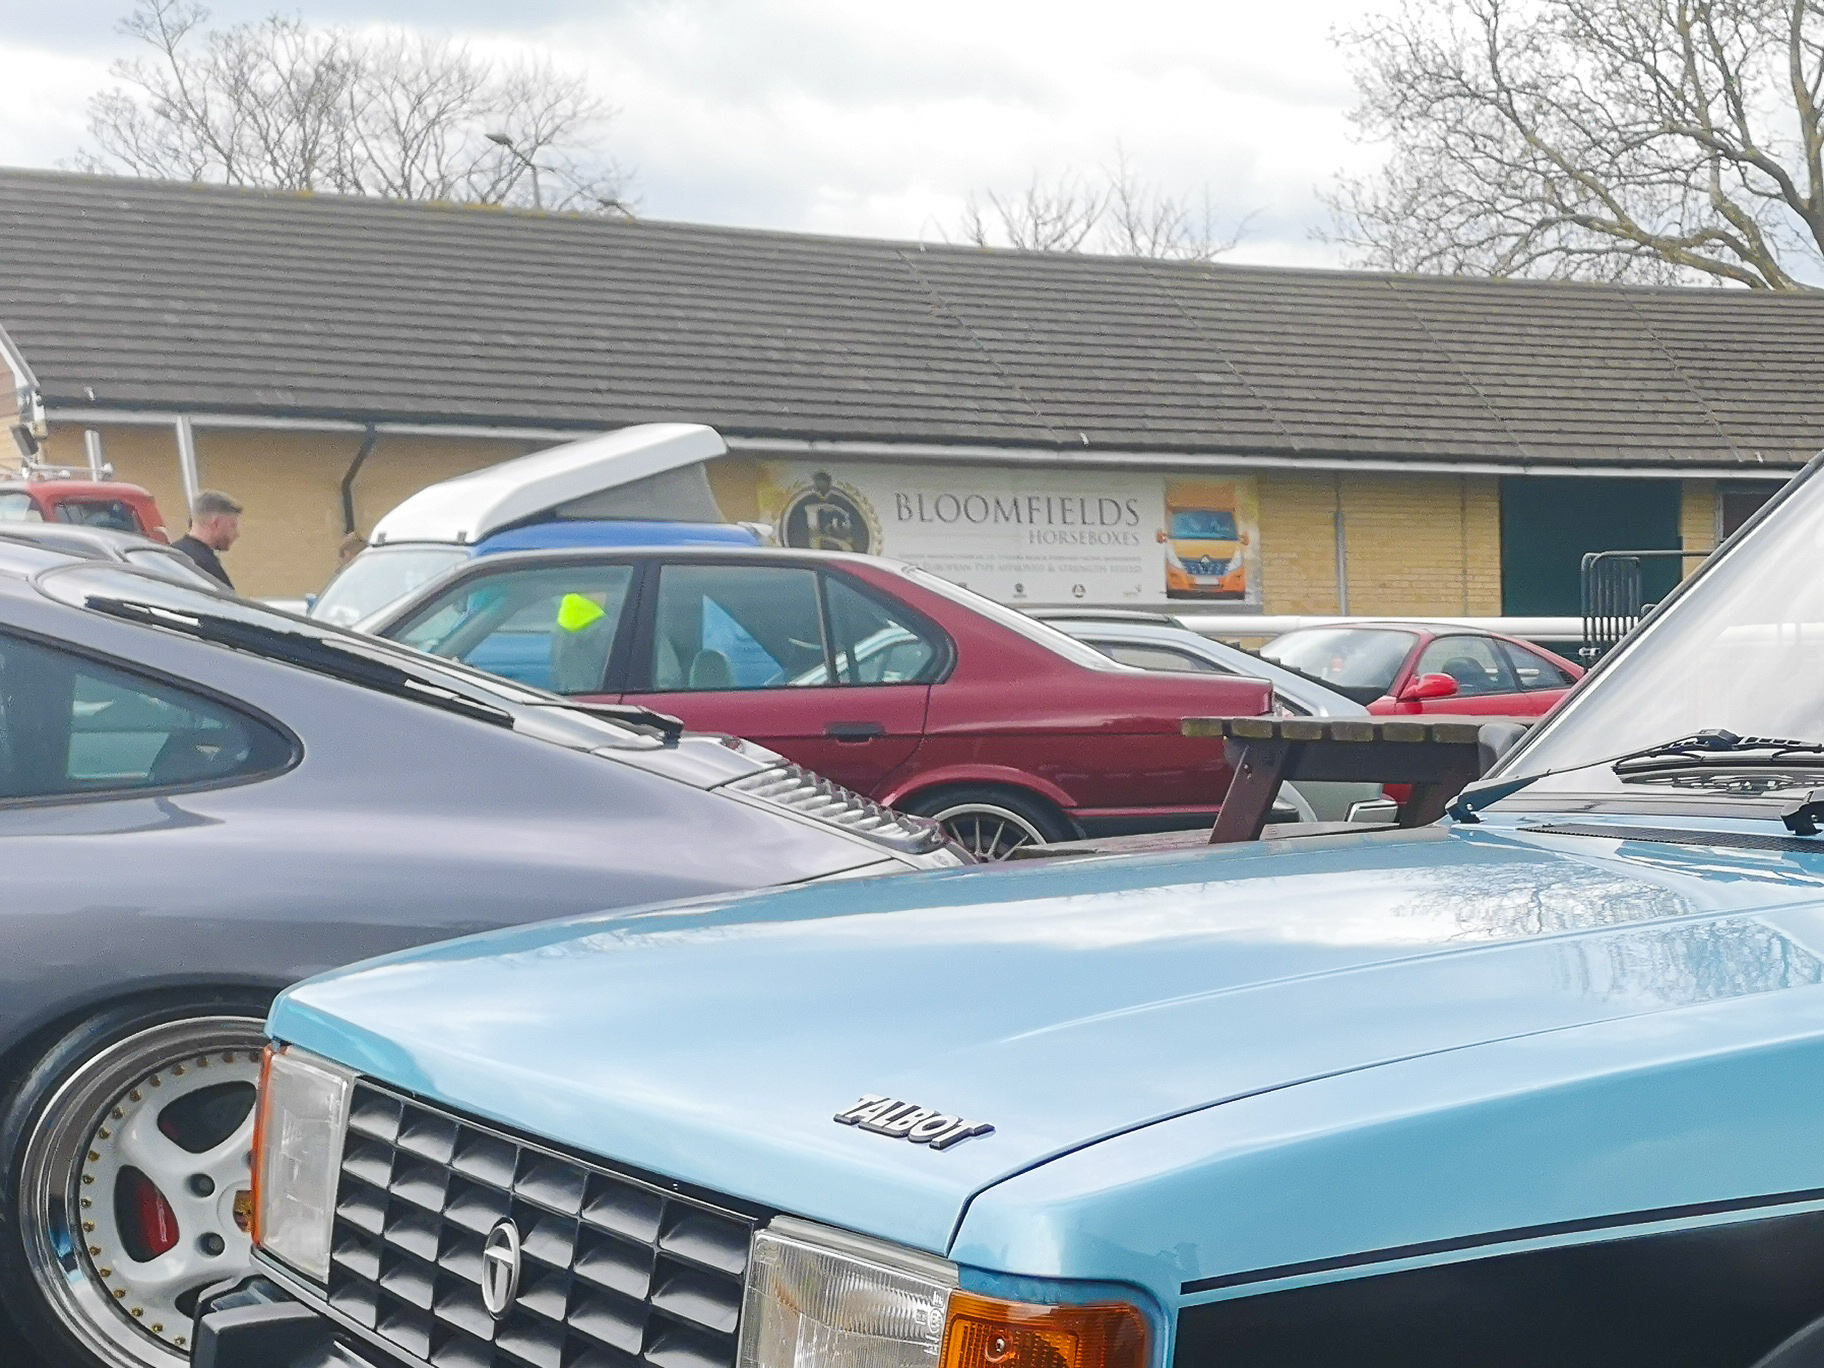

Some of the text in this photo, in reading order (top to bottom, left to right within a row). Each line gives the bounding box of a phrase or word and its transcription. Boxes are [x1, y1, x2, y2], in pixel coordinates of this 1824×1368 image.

[895, 492, 1140, 527] BLOOMFIELDS
[1028, 529, 1140, 546] HORSEBOXES
[832, 1093, 995, 1150] TALBOT
